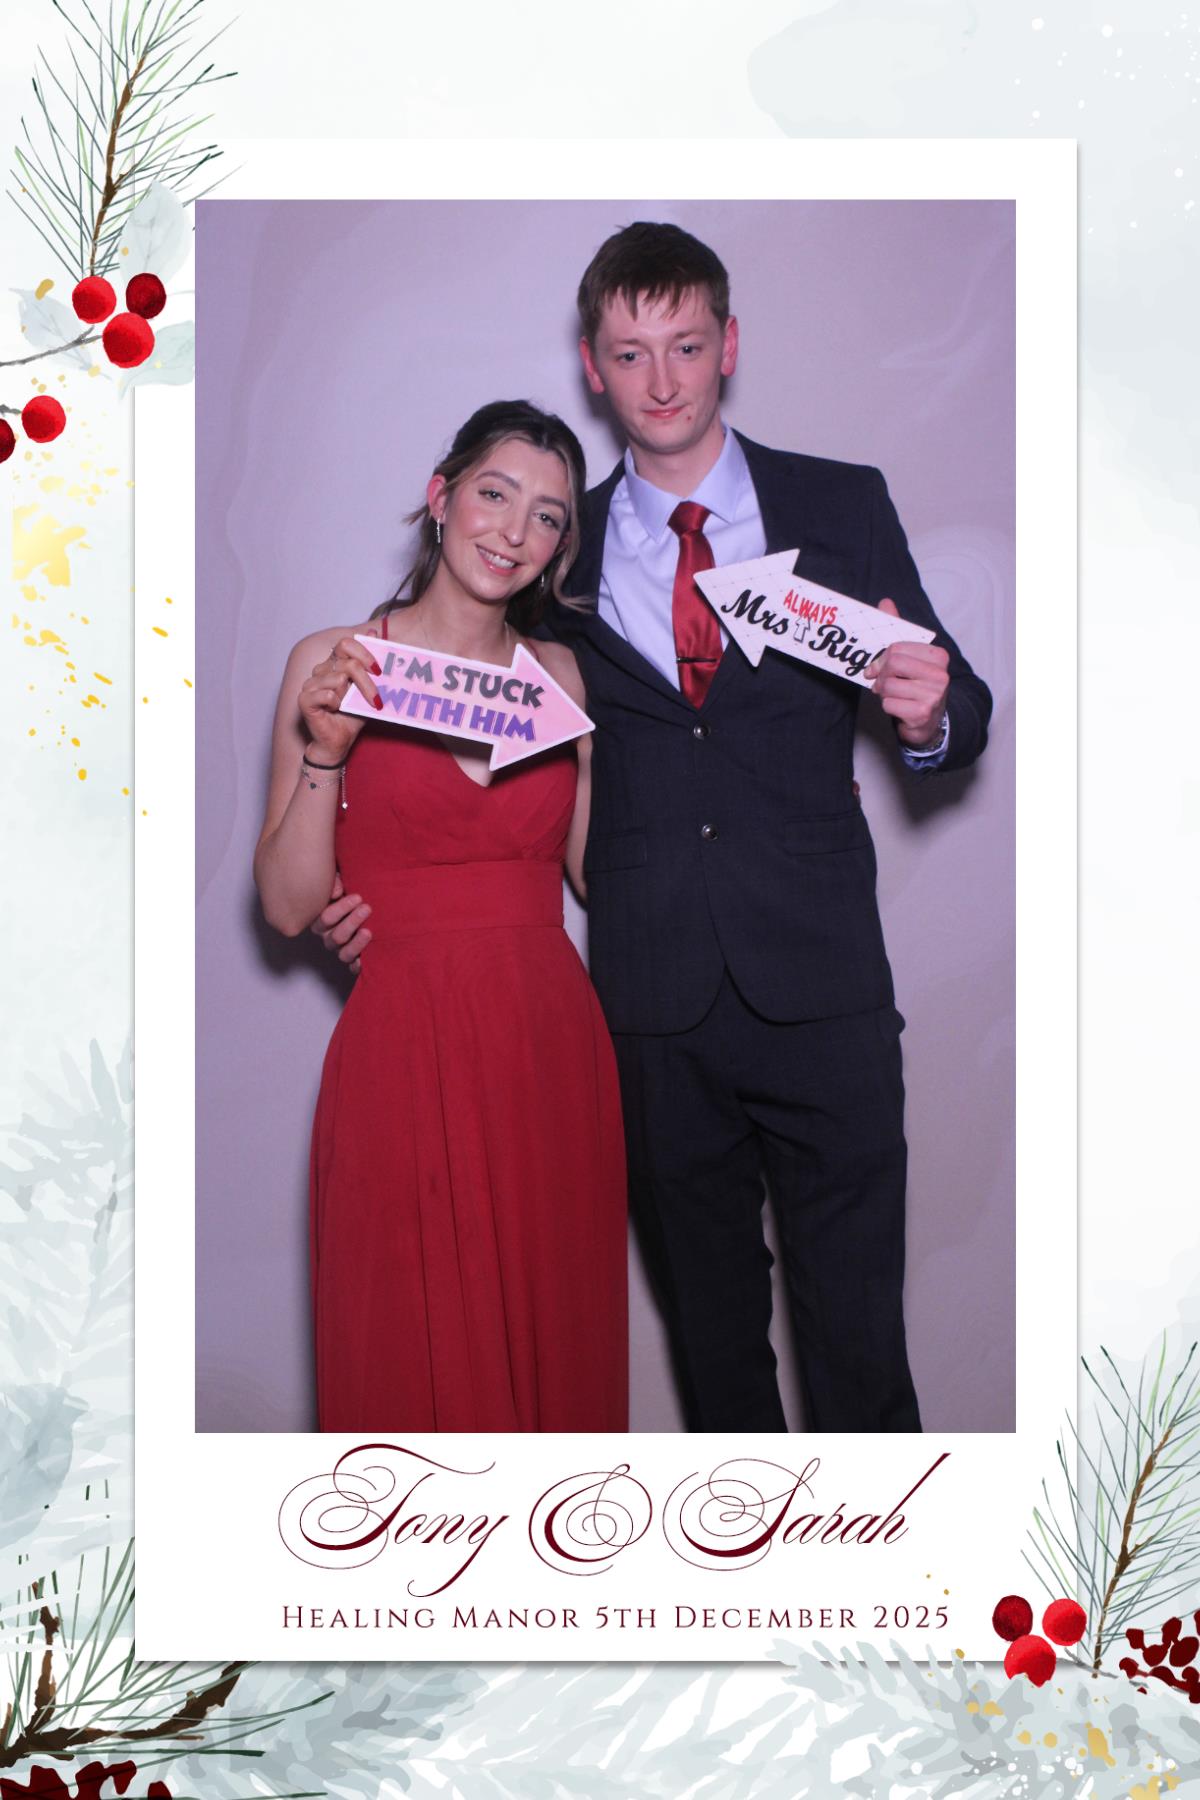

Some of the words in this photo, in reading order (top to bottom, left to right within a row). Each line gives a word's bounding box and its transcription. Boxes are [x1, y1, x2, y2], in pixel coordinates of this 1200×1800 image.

[721, 589, 789, 635] Mrs
[808, 624, 887, 676] Rig
[783, 589, 838, 625] ALWAYS
[382, 652, 433, 684] I'M
[442, 665, 545, 709] STUCK
[376, 684, 465, 727] WITH
[469, 704, 536, 742] HIM
